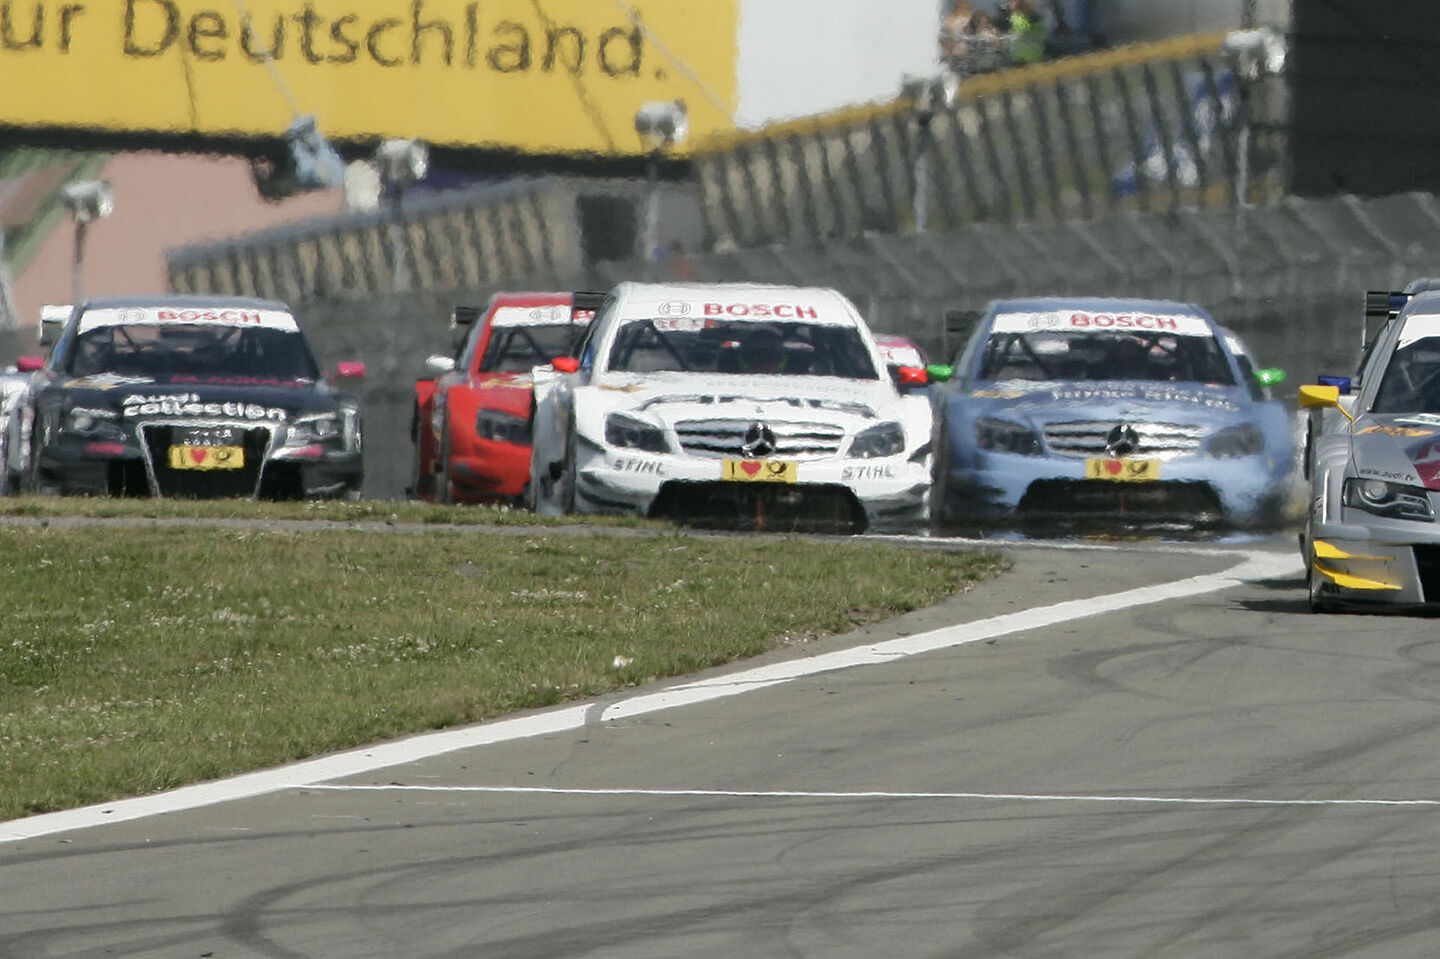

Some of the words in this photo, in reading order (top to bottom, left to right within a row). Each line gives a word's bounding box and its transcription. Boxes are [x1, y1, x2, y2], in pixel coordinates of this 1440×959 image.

[157, 310, 262, 325] BOSCH
[703, 302, 818, 319] BOSCH
[1071, 313, 1177, 329] BOSCH
[613, 458, 666, 476] STIHL
[841, 464, 898, 481] STIHL
[1360, 468, 1416, 482] www.audi.tv
